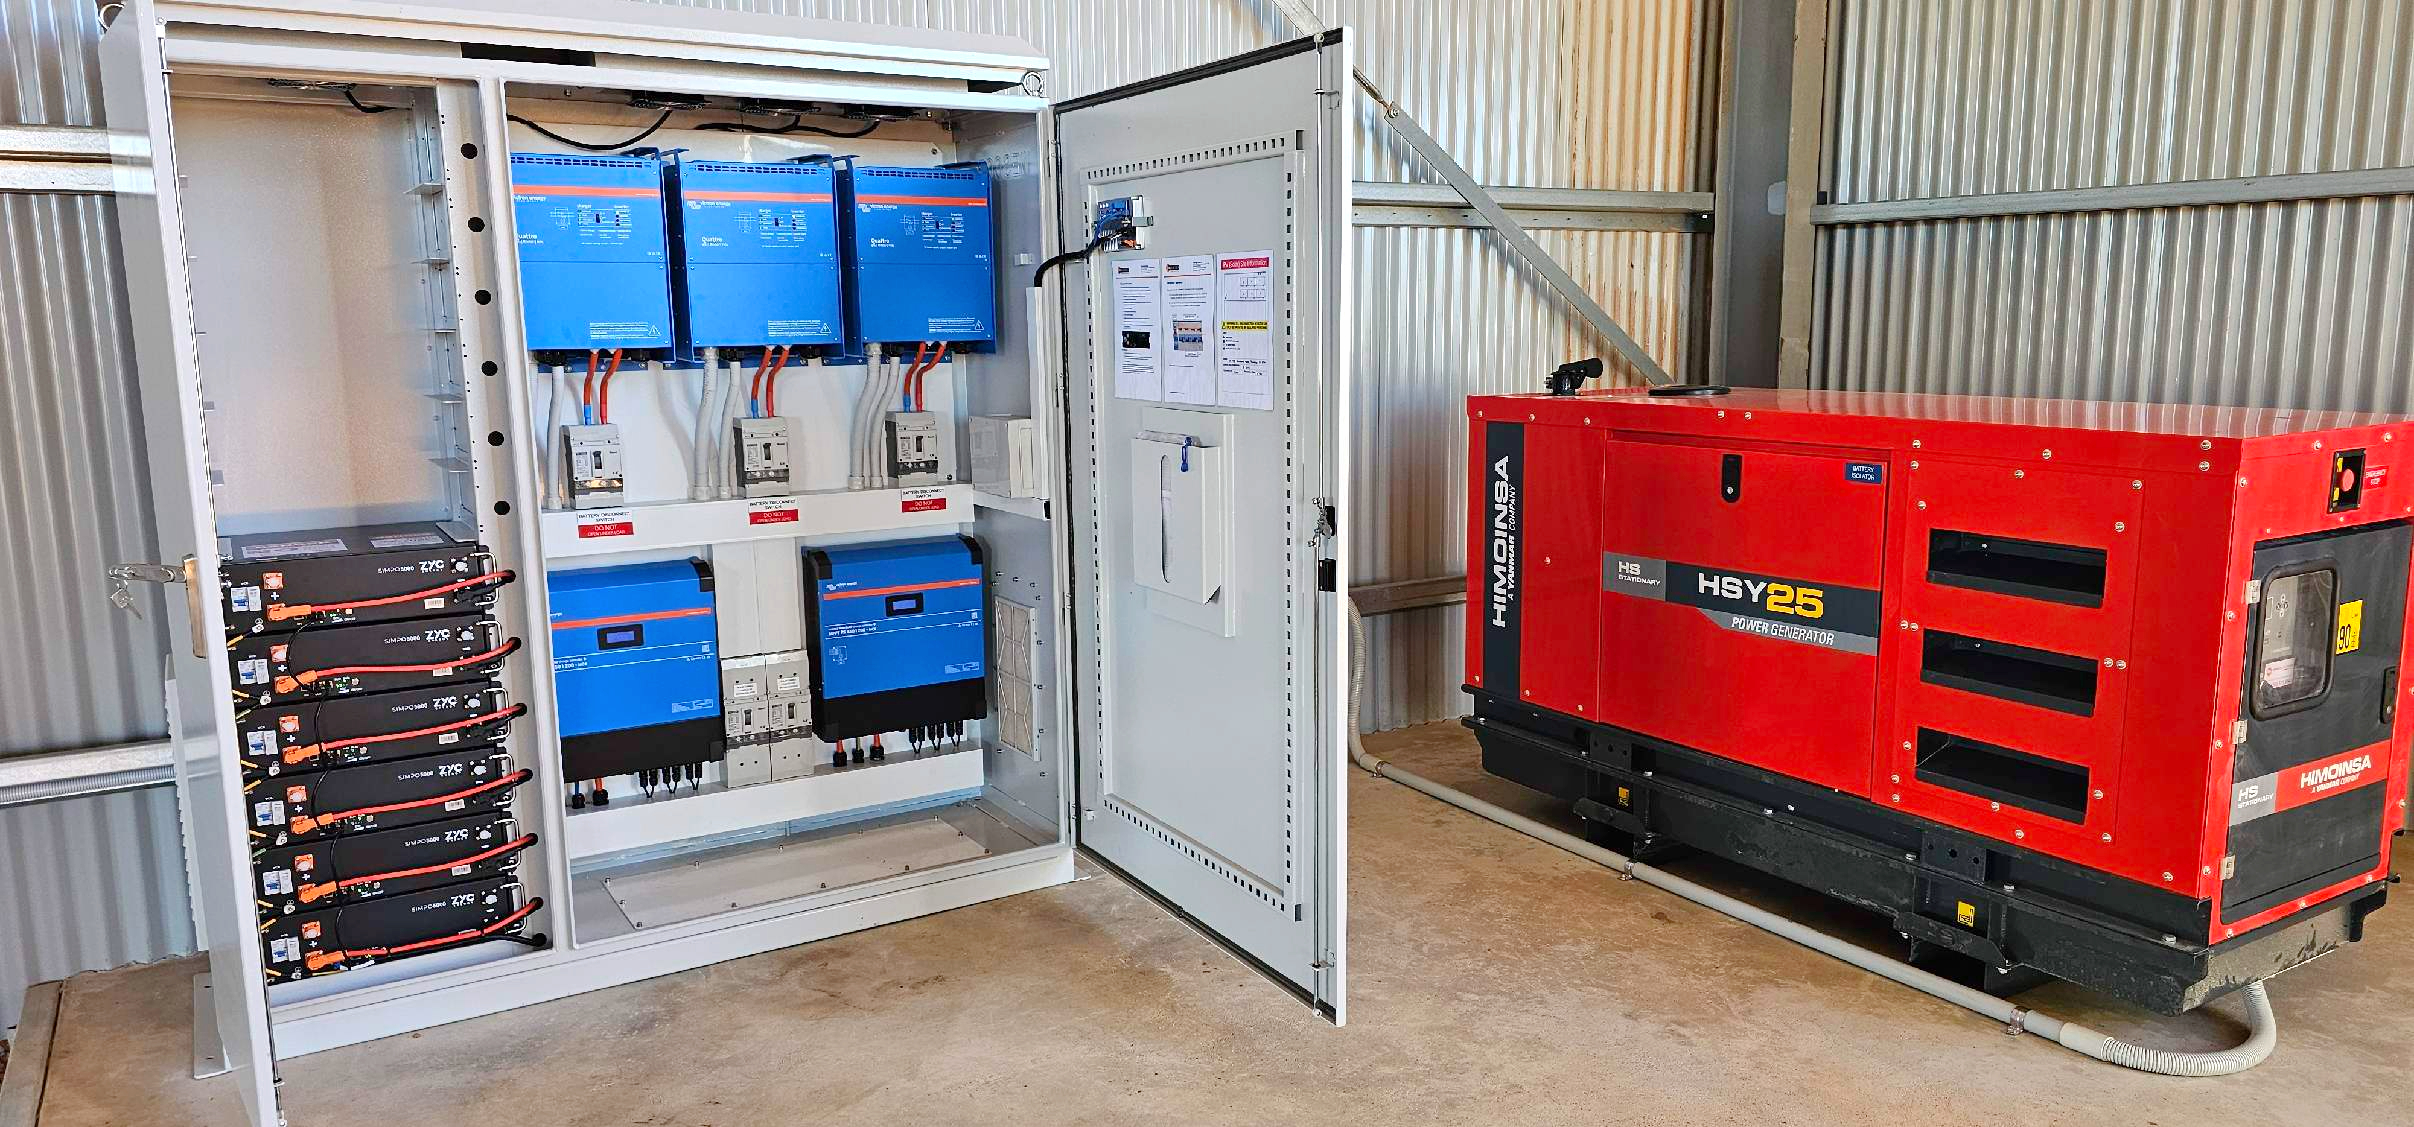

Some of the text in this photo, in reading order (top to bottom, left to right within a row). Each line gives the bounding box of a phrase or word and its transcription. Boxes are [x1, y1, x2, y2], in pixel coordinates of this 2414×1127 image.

[1852, 465, 1875, 473] BATTERY
[1851, 472, 1875, 481] ISOLATOR
[1492, 455, 1509, 628] HIMOINSA
[1507, 484, 1516, 601] A YANMAR COMPANY
[418, 559, 445, 571] ZYC
[1618, 560, 1641, 576] HS
[1618, 574, 1661, 587] STATIONARY
[1698, 572, 1824, 619] HSY25
[424, 628, 451, 641] ZYC
[1731, 616, 1835, 646] POWER GENERATOR
[2338, 623, 2351, 651] 90
[432, 695, 458, 708] ZYC
[438, 763, 463, 775] ZYC
[2300, 755, 2372, 789] HIMOINSA
[2237, 785, 2259, 802] HS
[2237, 793, 2274, 809] STATIONARY
[444, 828, 469, 840] ZYC
[450, 893, 475, 905] ZYC
